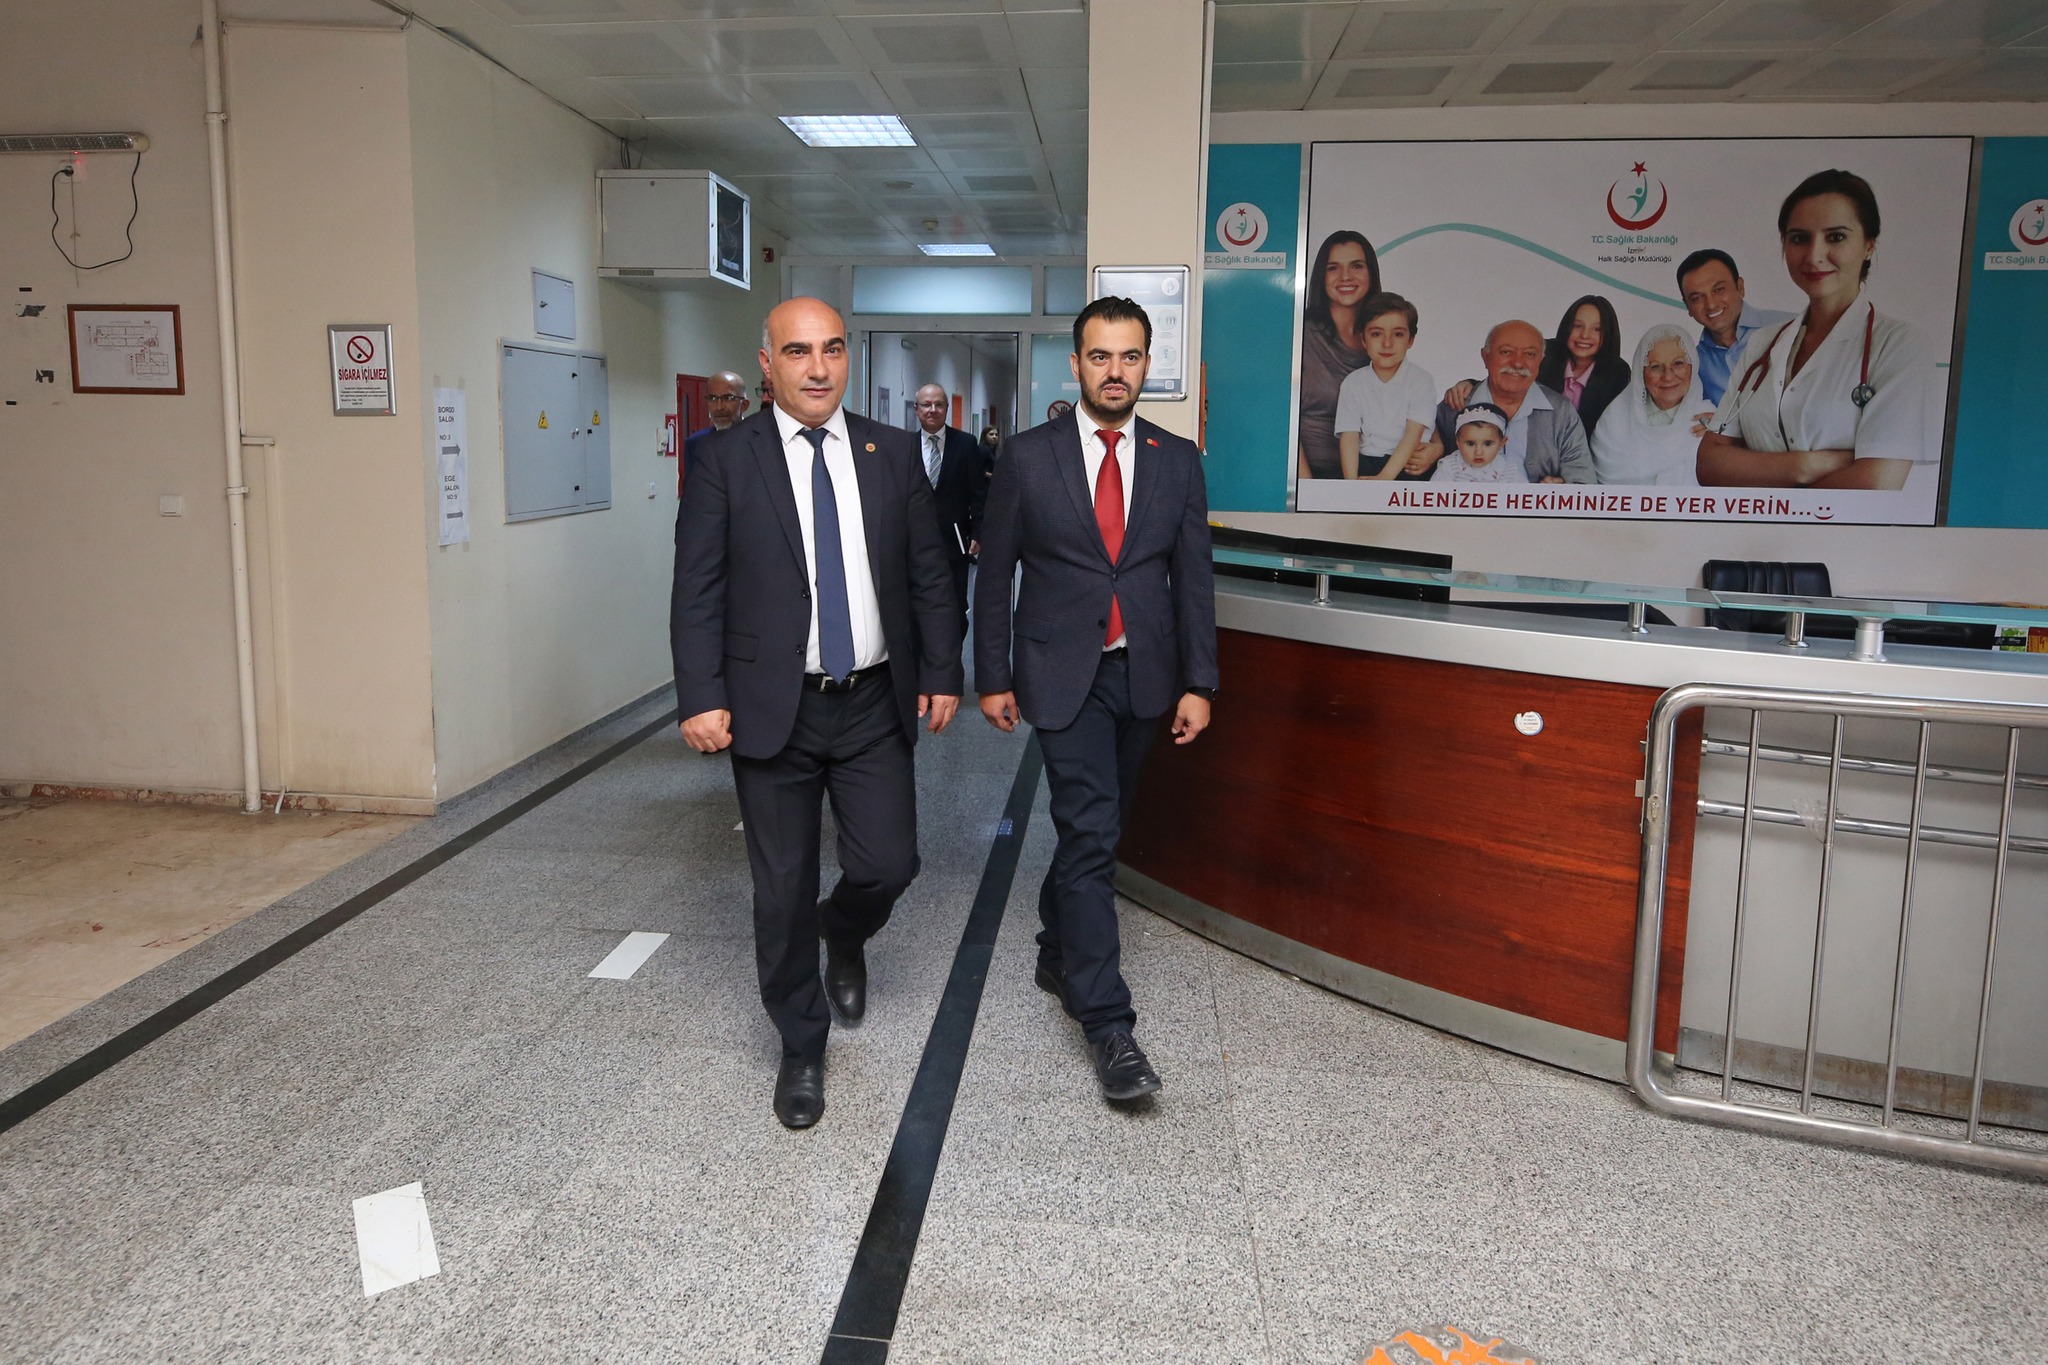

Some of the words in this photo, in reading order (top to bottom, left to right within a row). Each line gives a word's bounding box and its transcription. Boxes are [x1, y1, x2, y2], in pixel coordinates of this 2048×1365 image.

[1606, 235, 1634, 244] Sağlık
[1636, 235, 1678, 246] Bakanlığı
[1214, 255, 1242, 264] Sağlık
[1243, 255, 1284, 266] Bakanlığı
[2005, 255, 2036, 266] Sağlık
[338, 366, 360, 381] SİGARA
[361, 366, 387, 383] İÇİLMEZ
[1387, 488, 1498, 509] AİLENİZDE
[1506, 491, 1632, 512] HEKİMİNİZE
[1640, 496, 1668, 513] DE
[1675, 497, 1716, 514] YER
